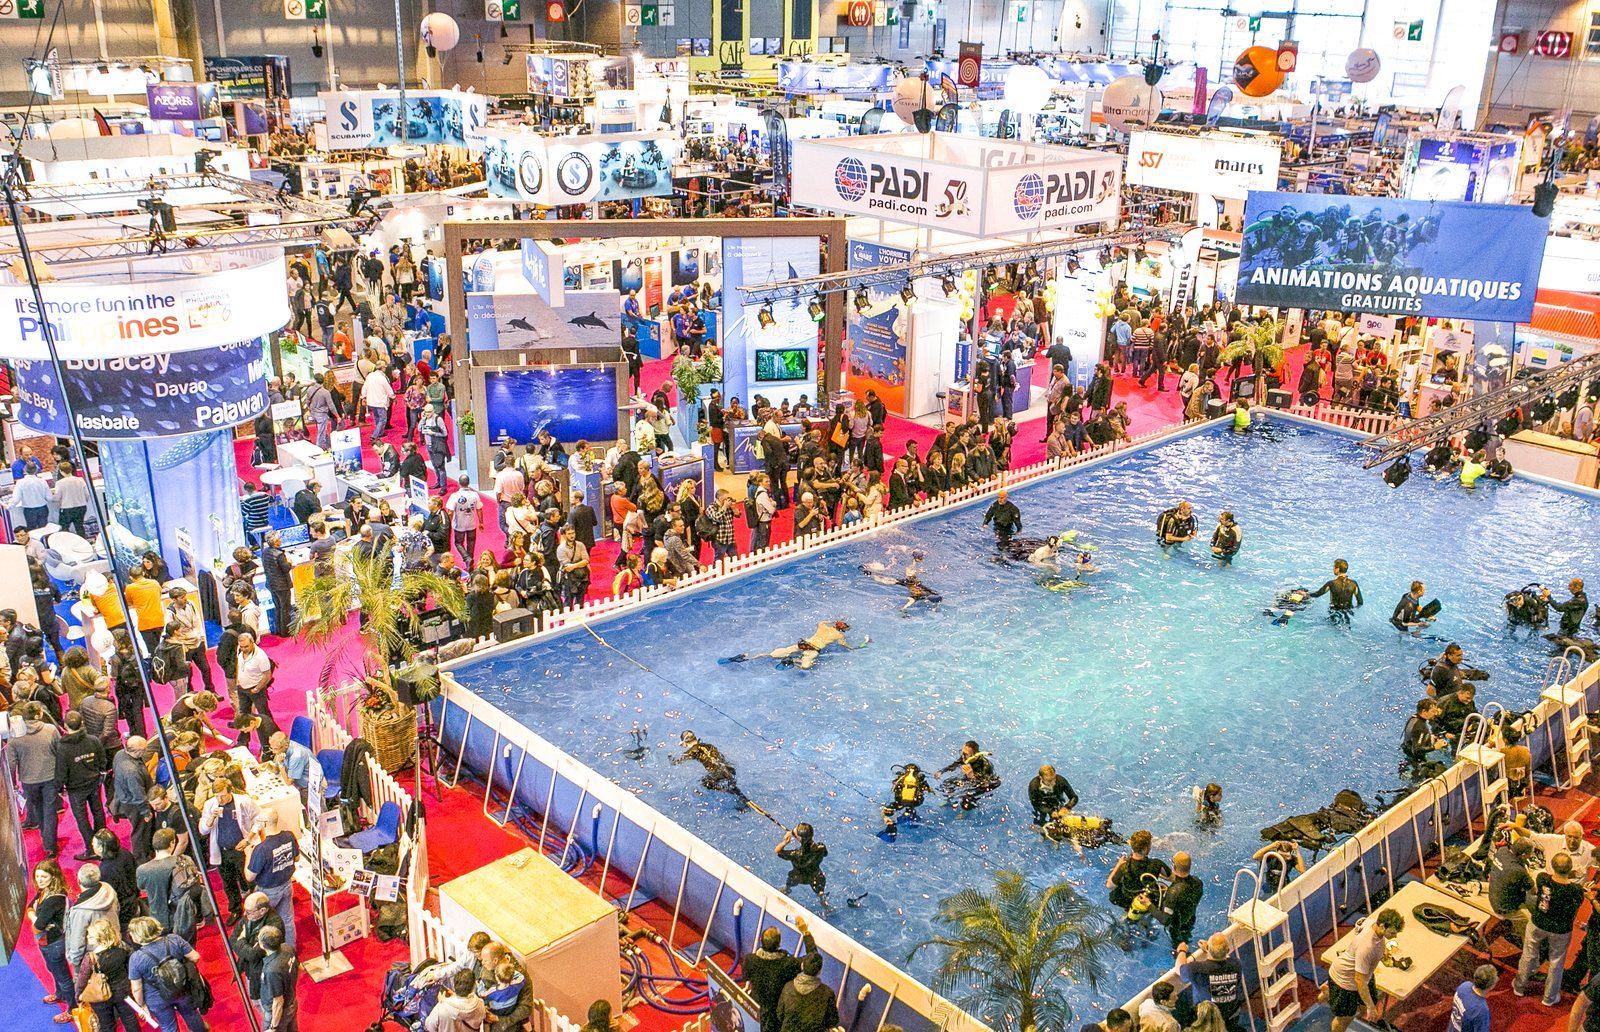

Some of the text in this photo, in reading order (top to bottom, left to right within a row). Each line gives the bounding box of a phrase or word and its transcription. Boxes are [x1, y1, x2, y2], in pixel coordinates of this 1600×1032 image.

[154, 94, 194, 106] AZORES
[1214, 158, 1264, 175] mares
[870, 163, 929, 202] PADI
[1045, 169, 1096, 204] PADI
[869, 198, 928, 216] padi.com
[1044, 204, 1093, 221] padi.com
[879, 255, 907, 264] VOYAG
[1250, 267, 1522, 302] ANIMATIONS AQUATIQUES
[15, 294, 175, 314] It's more fun in the
[1341, 294, 1422, 312] GRATUITES
[155, 380, 208, 398] Davao
[33, 392, 54, 413] Bay
[196, 391, 264, 428] Palawan
